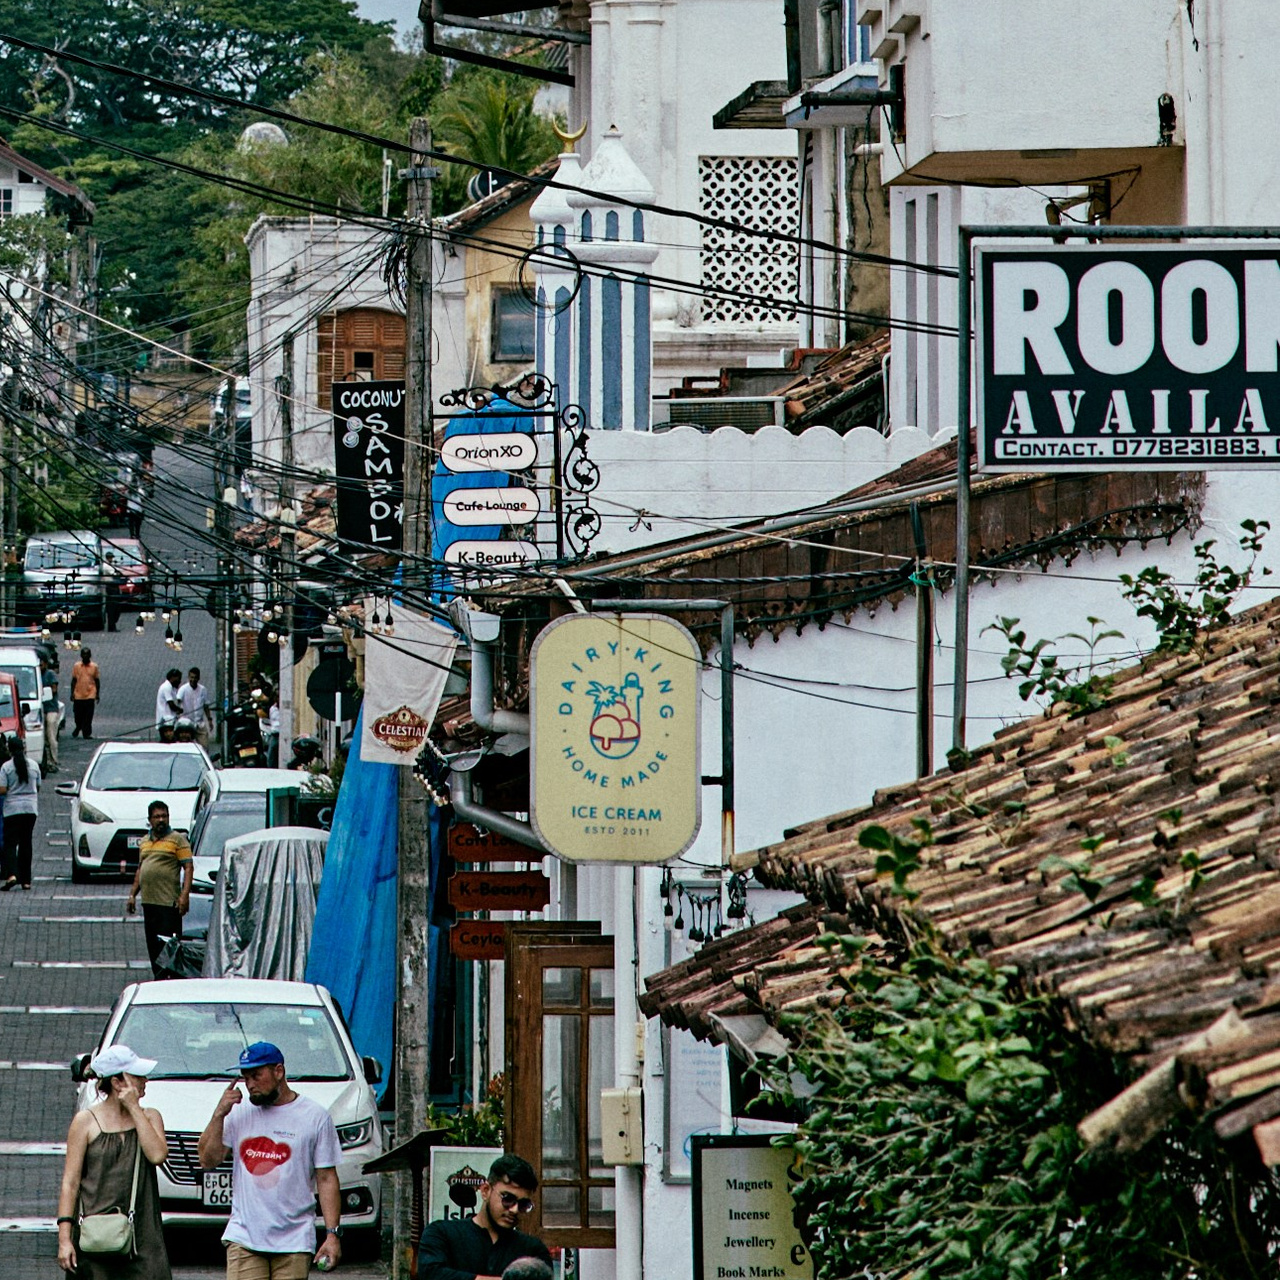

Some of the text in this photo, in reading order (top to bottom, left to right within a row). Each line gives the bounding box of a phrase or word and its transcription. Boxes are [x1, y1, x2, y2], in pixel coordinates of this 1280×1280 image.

[340, 389, 406, 408] COCONU
[1002, 389, 1270, 434] AVAILA
[364, 413, 393, 542] SAMBOL
[456, 500, 527, 513] Cafe Lounge
[458, 551, 527, 566] K-Beauty
[559, 641, 675, 719] DAIRY KING
[562, 746, 668, 789] HOME MADE
[572, 806, 662, 821] ICE CREAM
[584, 826, 650, 836] ESTD 2011
[459, 931, 502, 948] Ceylo
[726, 1178, 774, 1193] Magnets
[728, 1208, 771, 1220] Incense
[723, 1236, 776, 1250] Jewellery
[717, 1266, 786, 1278] Book Marks
